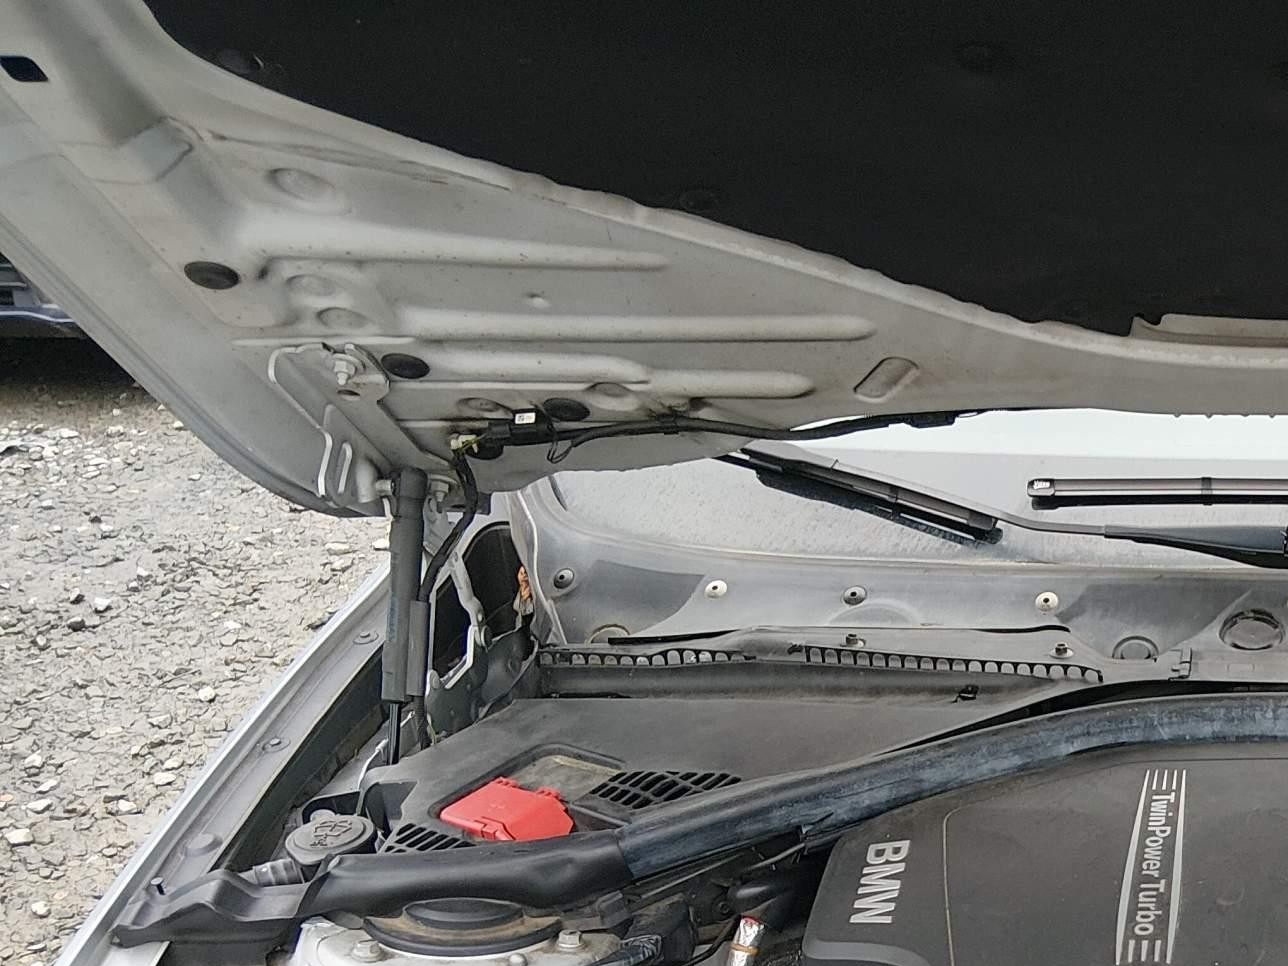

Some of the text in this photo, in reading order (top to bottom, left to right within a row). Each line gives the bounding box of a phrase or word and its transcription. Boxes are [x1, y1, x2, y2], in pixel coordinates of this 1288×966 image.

[849, 840, 911, 924] BMW
[1133, 791, 1175, 936] TwinPower Turbo
